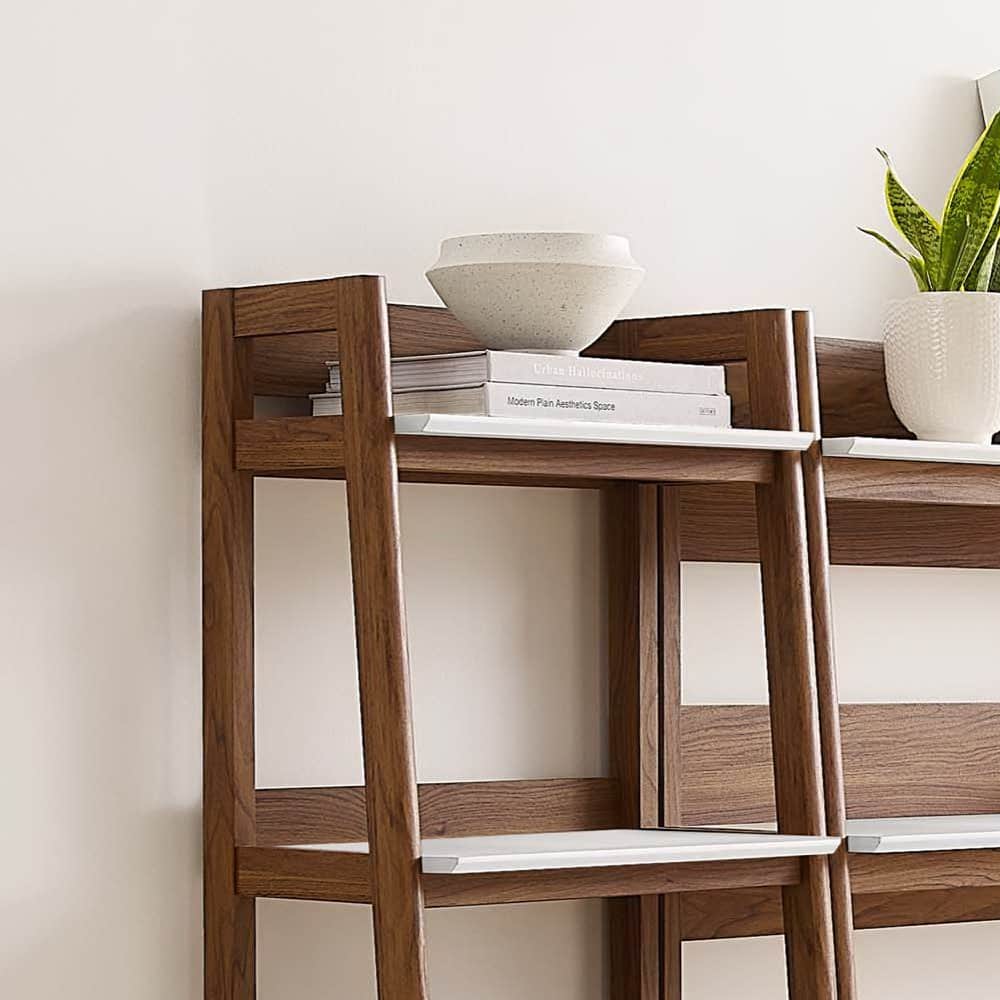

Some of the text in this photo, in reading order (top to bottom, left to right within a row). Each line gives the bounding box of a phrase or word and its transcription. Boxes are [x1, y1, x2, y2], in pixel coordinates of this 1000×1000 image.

[533, 363, 564, 376] Urban
[507, 396, 616, 412] Modern Plain Aesthetics Space
